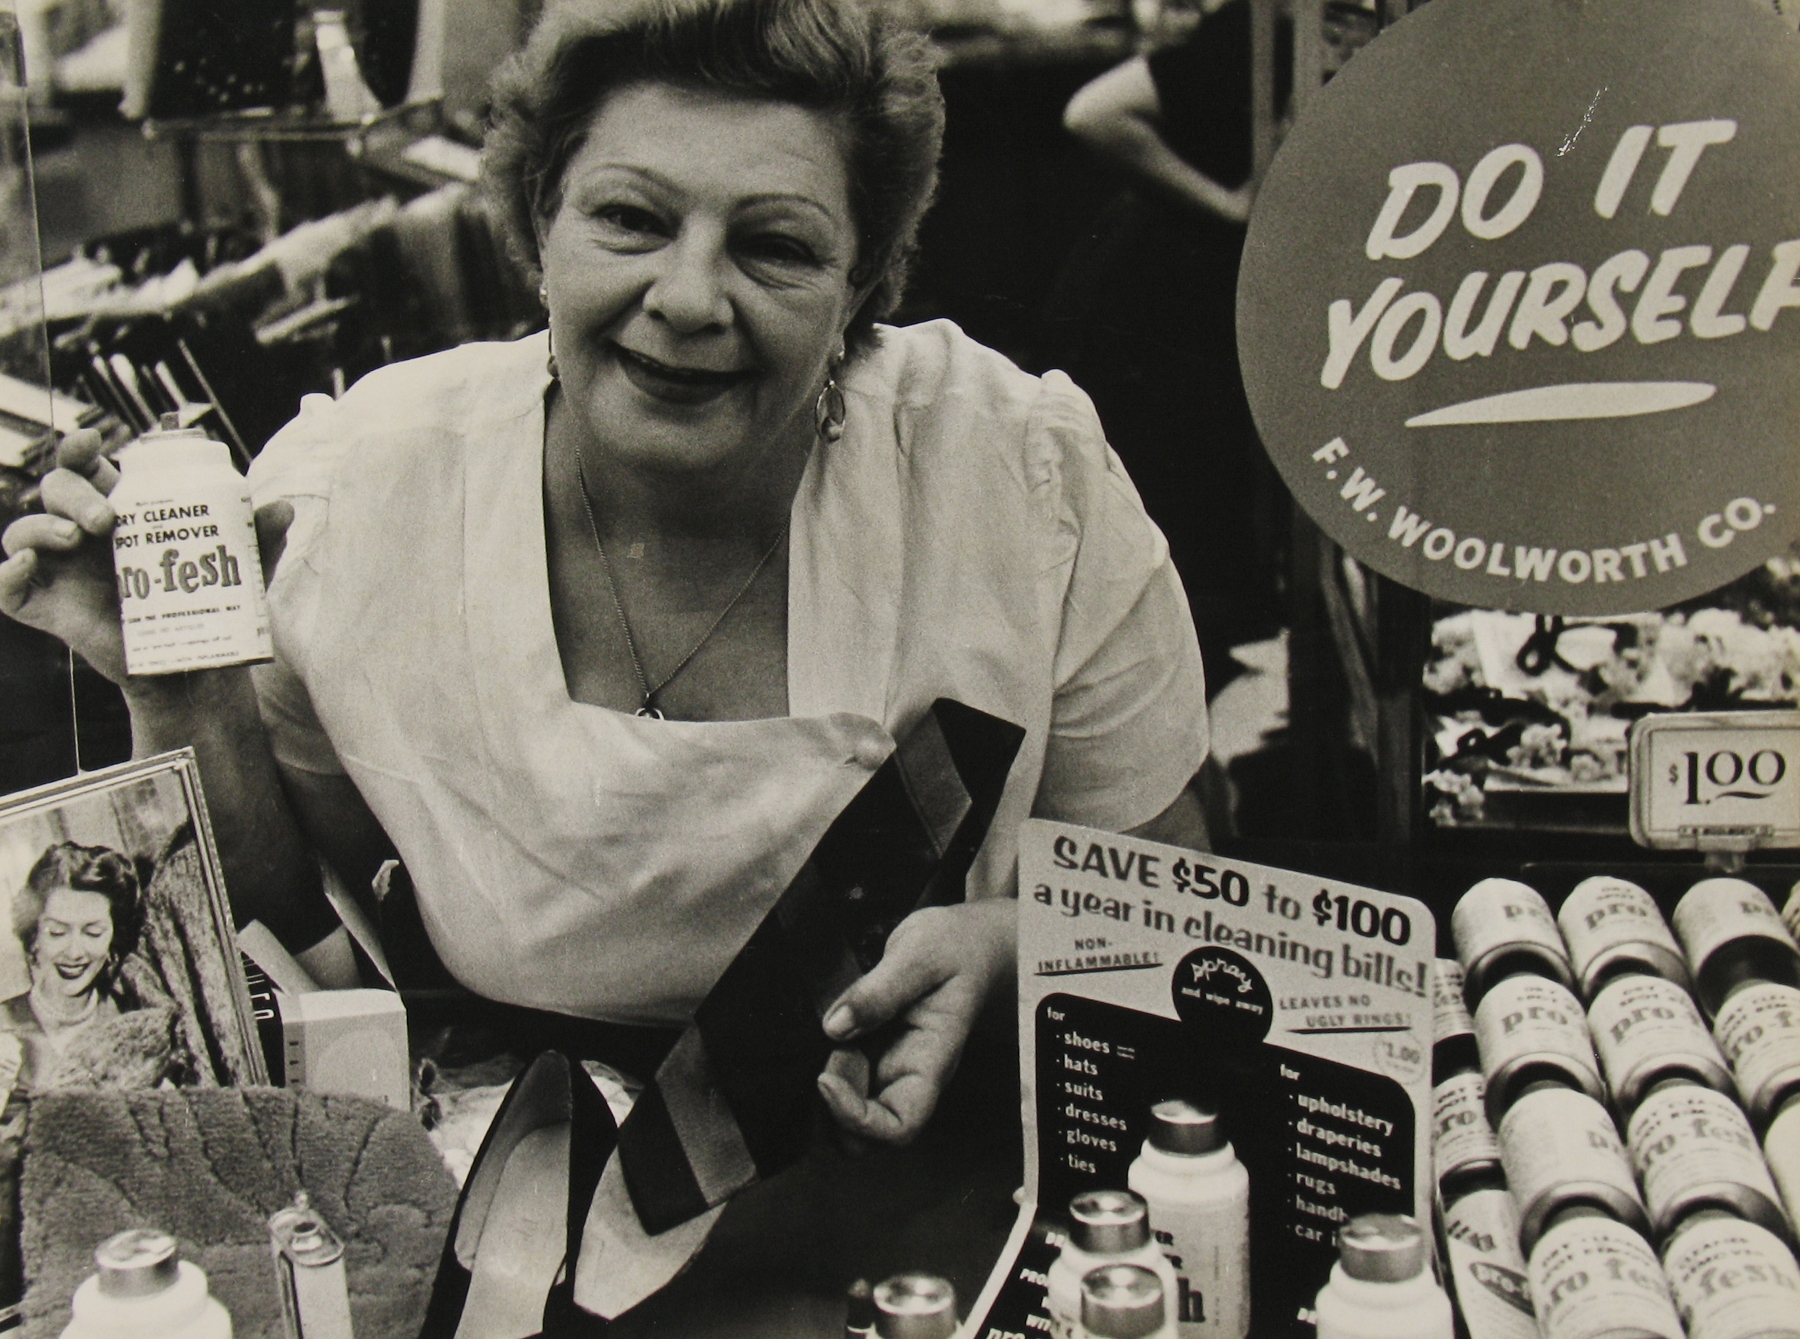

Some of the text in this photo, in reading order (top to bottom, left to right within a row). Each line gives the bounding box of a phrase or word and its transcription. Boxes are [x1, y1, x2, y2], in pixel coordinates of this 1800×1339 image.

[1365, 118, 1737, 260] DO IT
[1320, 240, 1800, 389] YOURSELF
[144, 504, 209, 523] CLEANER
[146, 524, 219, 544] REMOVER
[1387, 505, 1689, 583] WOOLWORTH
[1698, 497, 1776, 548] CO.
[116, 545, 242, 600] ro-fesh
[1669, 750, 1786, 804] $1.00
[1053, 835, 1411, 946] SAVE $50 to $100
[1034, 883, 1052, 906] a
[1060, 888, 1134, 922] year
[1143, 900, 1174, 933] in
[1183, 910, 1333, 979] cleaning
[1342, 943, 1427, 998] bills!
[1075, 938, 1112, 950] NON-
[1038, 952, 1158, 972] INFLAMMABLE!
[1280, 994, 1371, 1010] LEAVES NO
[1047, 1006, 1065, 1021] for
[1306, 1015, 1344, 1028] UGLY
[1064, 1031, 1110, 1054] shoes
[1064, 1053, 1098, 1075] hats
[1280, 1063, 1300, 1081] for
[1065, 1082, 1103, 1100] suits
[1065, 1103, 1127, 1131] dresses
[1298, 1094, 1393, 1136] upholstery
[1067, 1128, 1117, 1152] gloves
[1297, 1117, 1382, 1157] draperies
[1068, 1153, 1096, 1173] ties
[1296, 1142, 1401, 1190] lampshades
[1296, 1173, 1336, 1195] rugs
[1295, 1224, 1323, 1242] car
